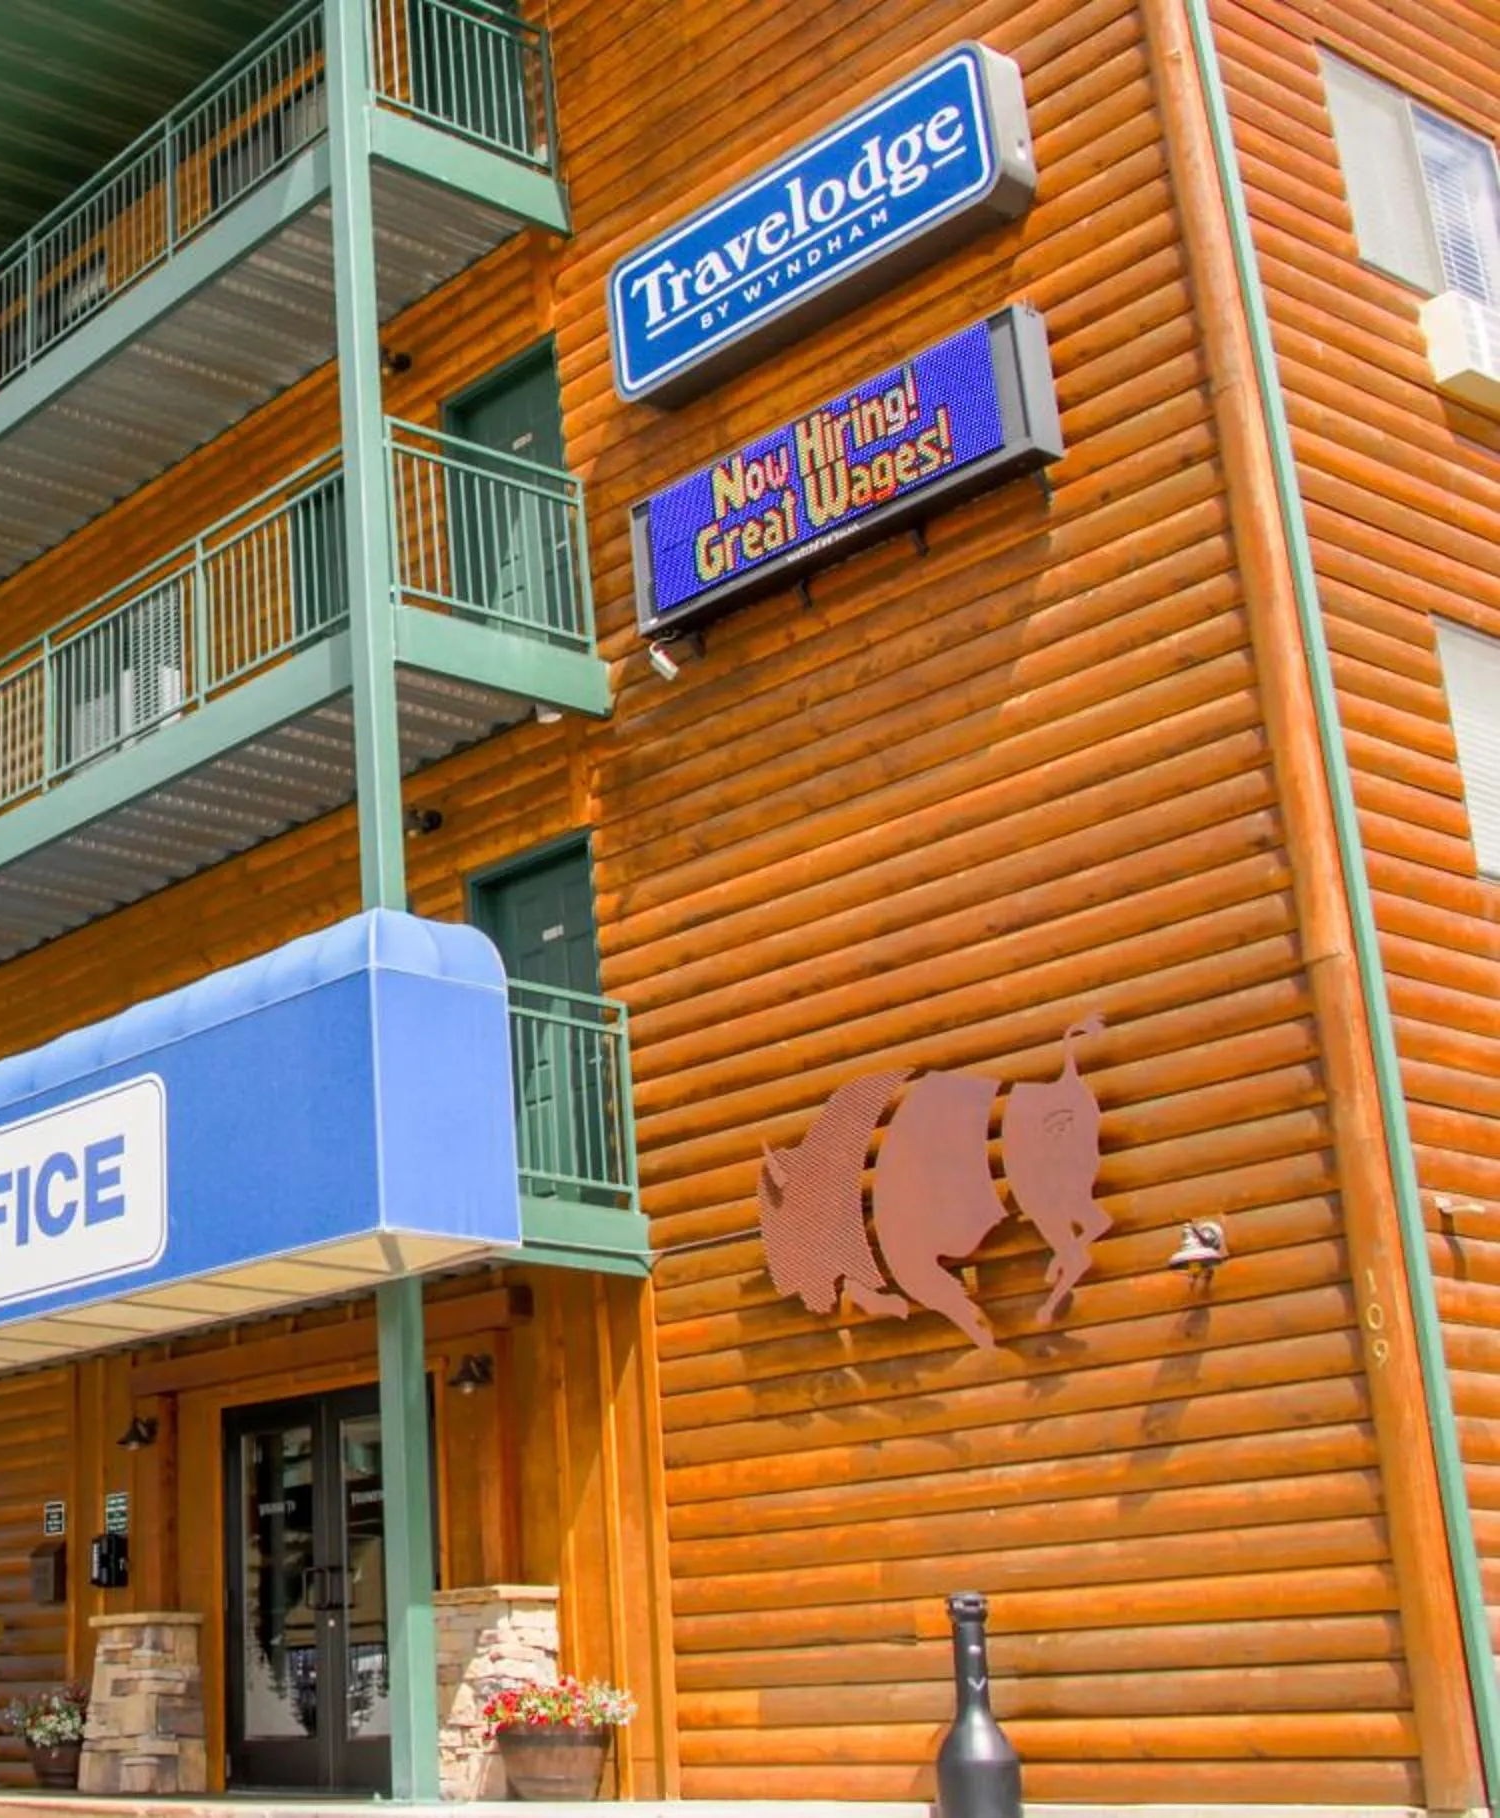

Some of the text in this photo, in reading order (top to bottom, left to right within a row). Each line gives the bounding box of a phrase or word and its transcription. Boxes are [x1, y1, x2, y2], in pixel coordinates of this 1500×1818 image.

[630, 105, 964, 328] Travelodge
[700, 208, 888, 329] BY WYNDHAM
[695, 404, 954, 582] Great Wages!
[711, 363, 919, 520] Now Hiring!
